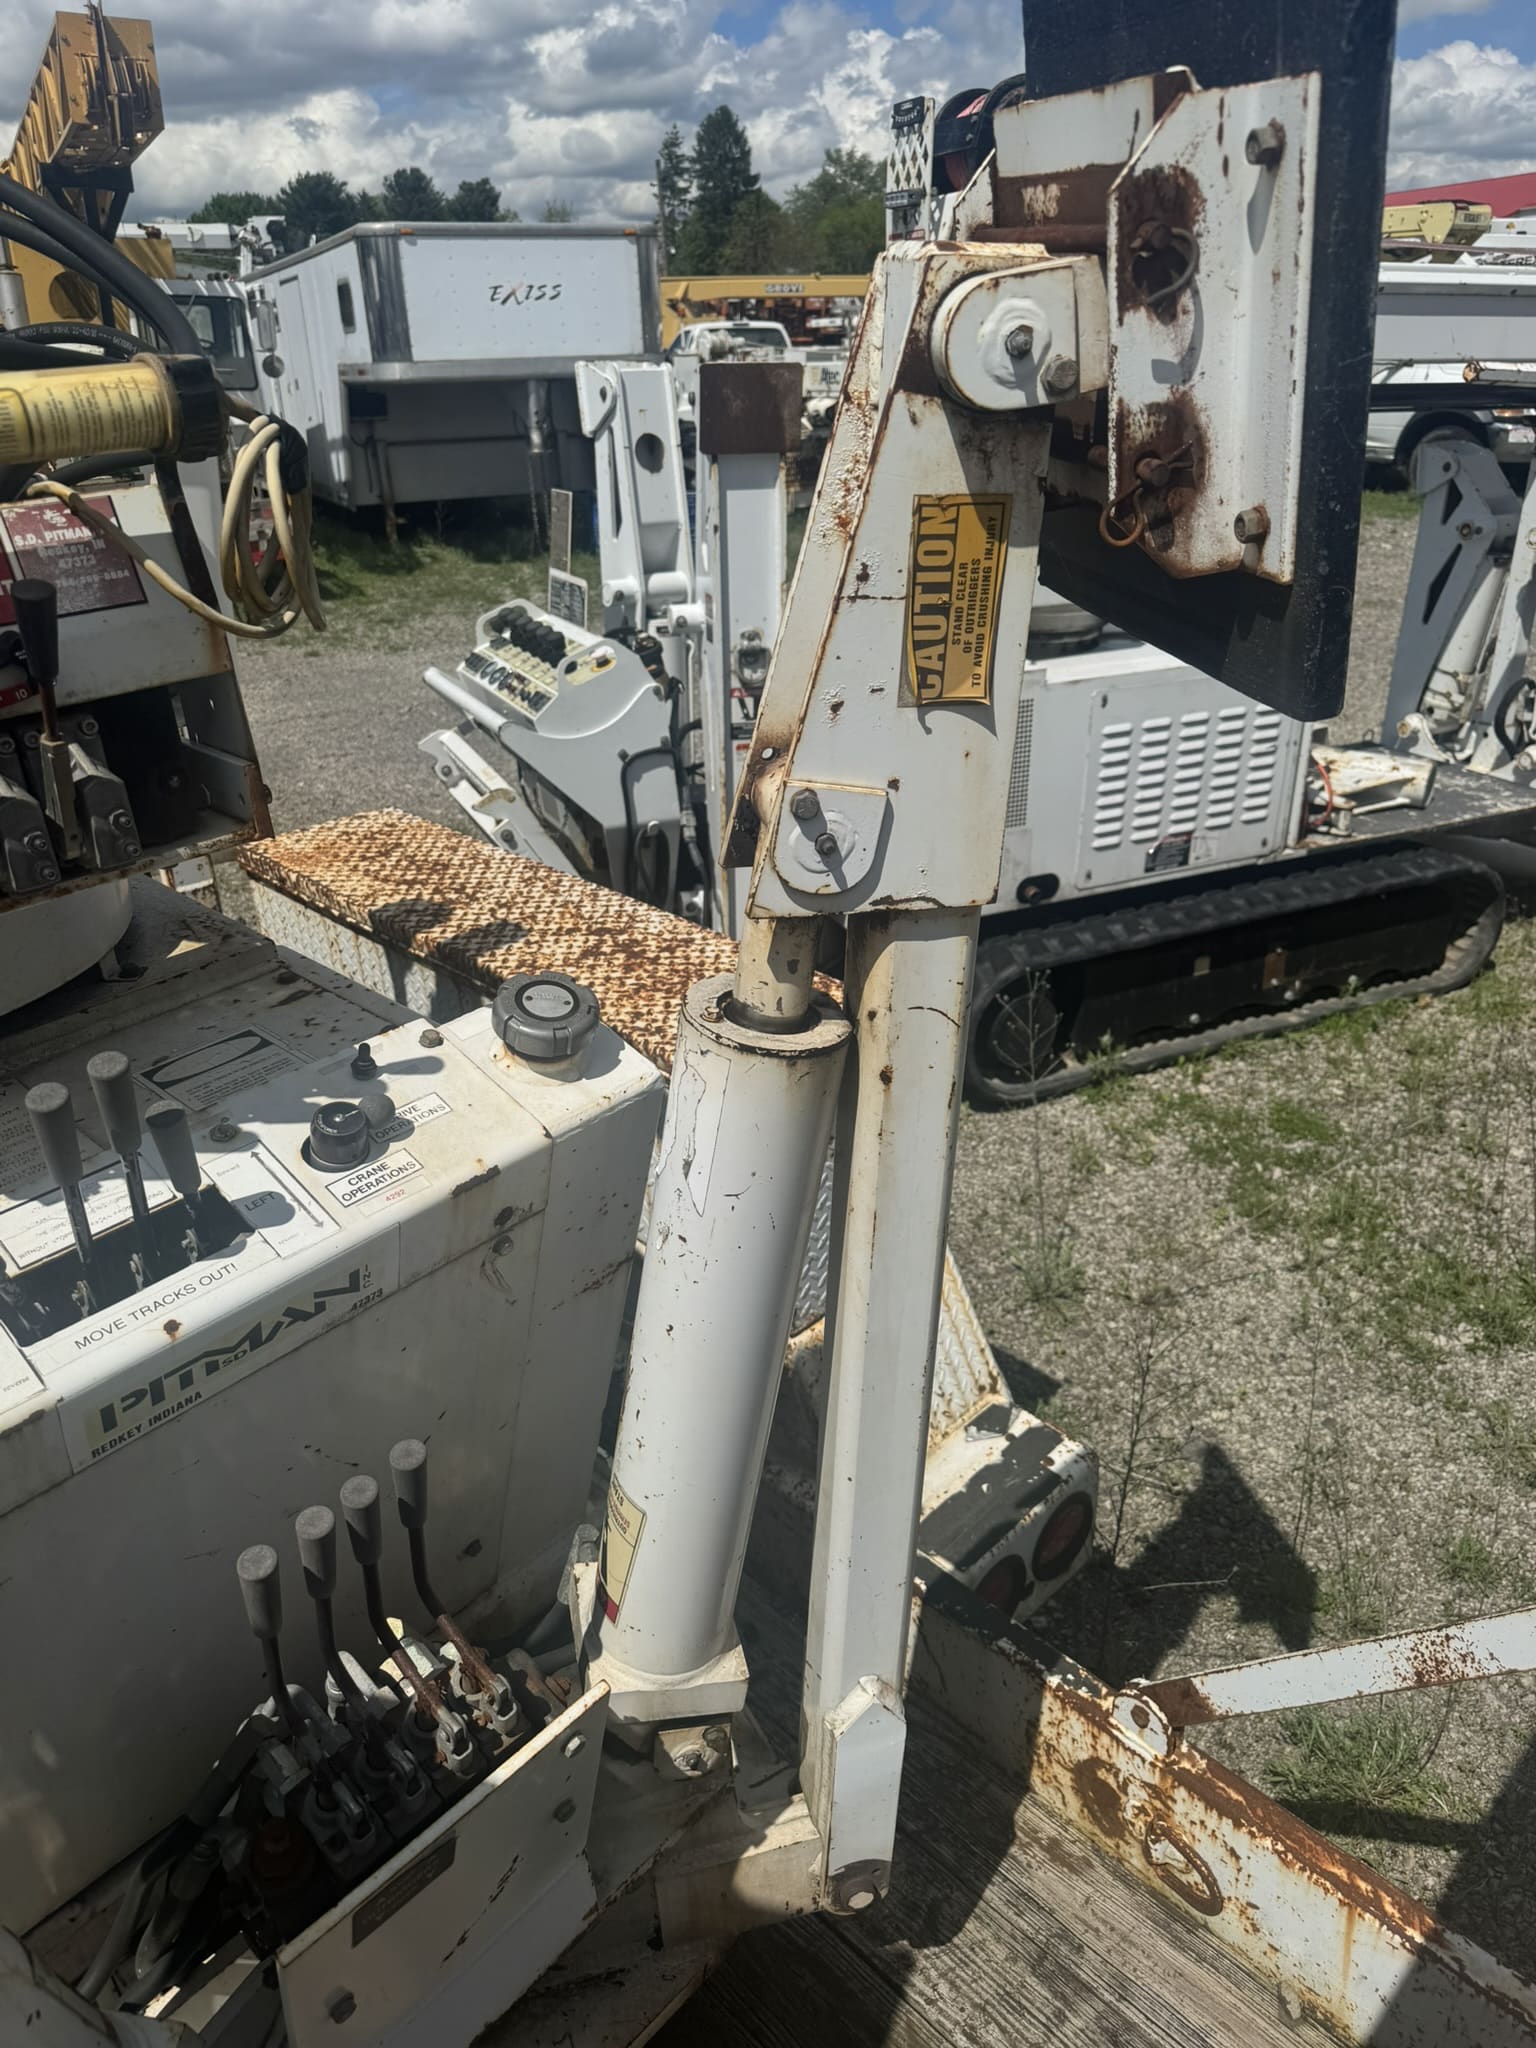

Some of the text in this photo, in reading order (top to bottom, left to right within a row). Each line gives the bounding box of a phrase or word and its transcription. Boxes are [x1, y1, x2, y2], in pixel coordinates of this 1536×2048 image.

[488, 282, 562, 305] EXISS
[913, 505, 957, 698] CAUTION
[952, 562, 968, 645] STAND CLEAR
[963, 558, 981, 654] OF OUTRIGGERS
[972, 517, 997, 688] TO AVOID CRUSHING INJURY
[375, 1103, 447, 1140] OPERATIONS
[391, 1103, 423, 1122] RIVE
[341, 1160, 417, 1202] OPERATIONS
[347, 1161, 392, 1186] CRANE
[385, 1188, 406, 1203] 4292
[244, 1191, 276, 1212] LEFT
[74, 1262, 239, 1351] MOVE TRACKS OUT!
[100, 1268, 360, 1433] PITMAN
[91, 1391, 203, 1459] REDKEY INDIANA
